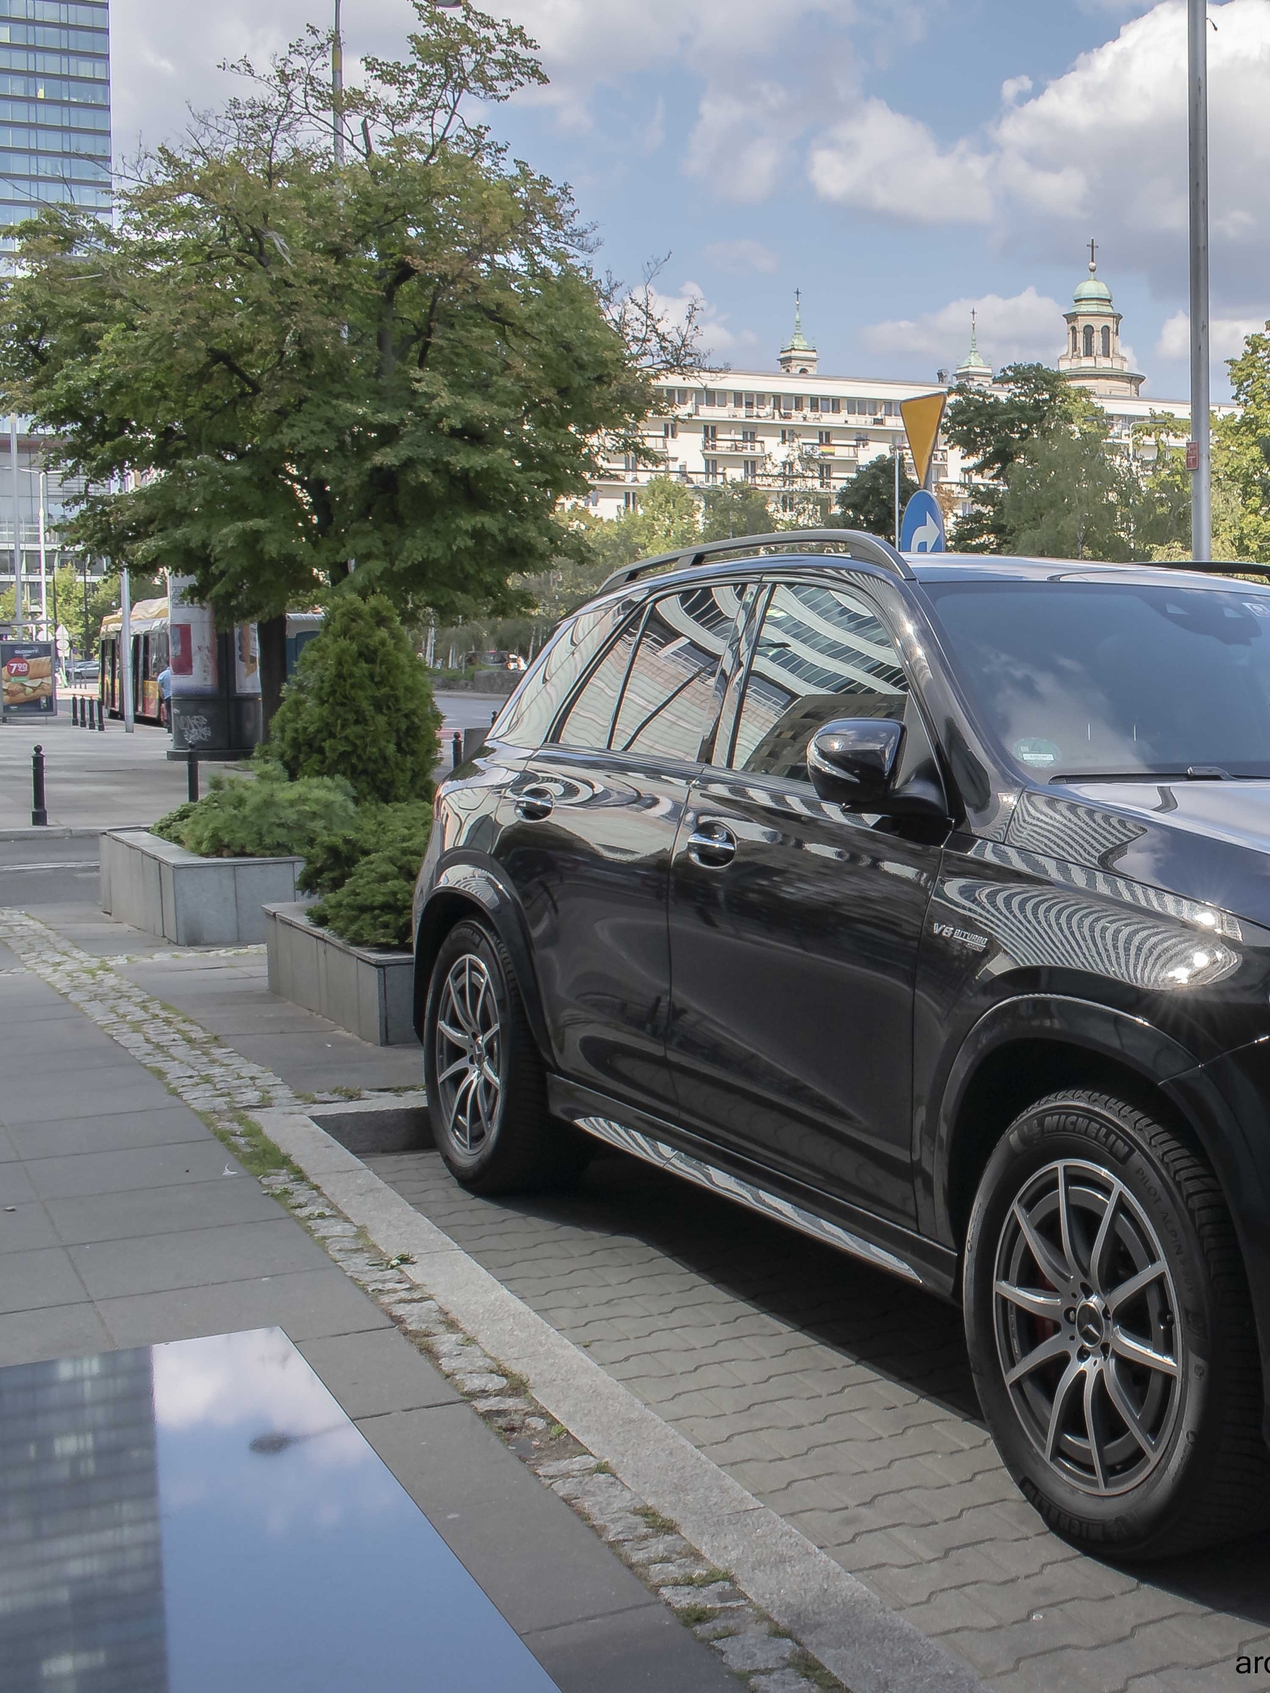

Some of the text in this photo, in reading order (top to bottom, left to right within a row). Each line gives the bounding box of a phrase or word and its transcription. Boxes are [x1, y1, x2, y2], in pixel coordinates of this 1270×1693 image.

[933, 922, 954, 938] V8
[1044, 1115, 1130, 1159] MICHELIN
[1136, 1167, 1163, 1205] PILOT
[1160, 1211, 1184, 1257] ALPIN
